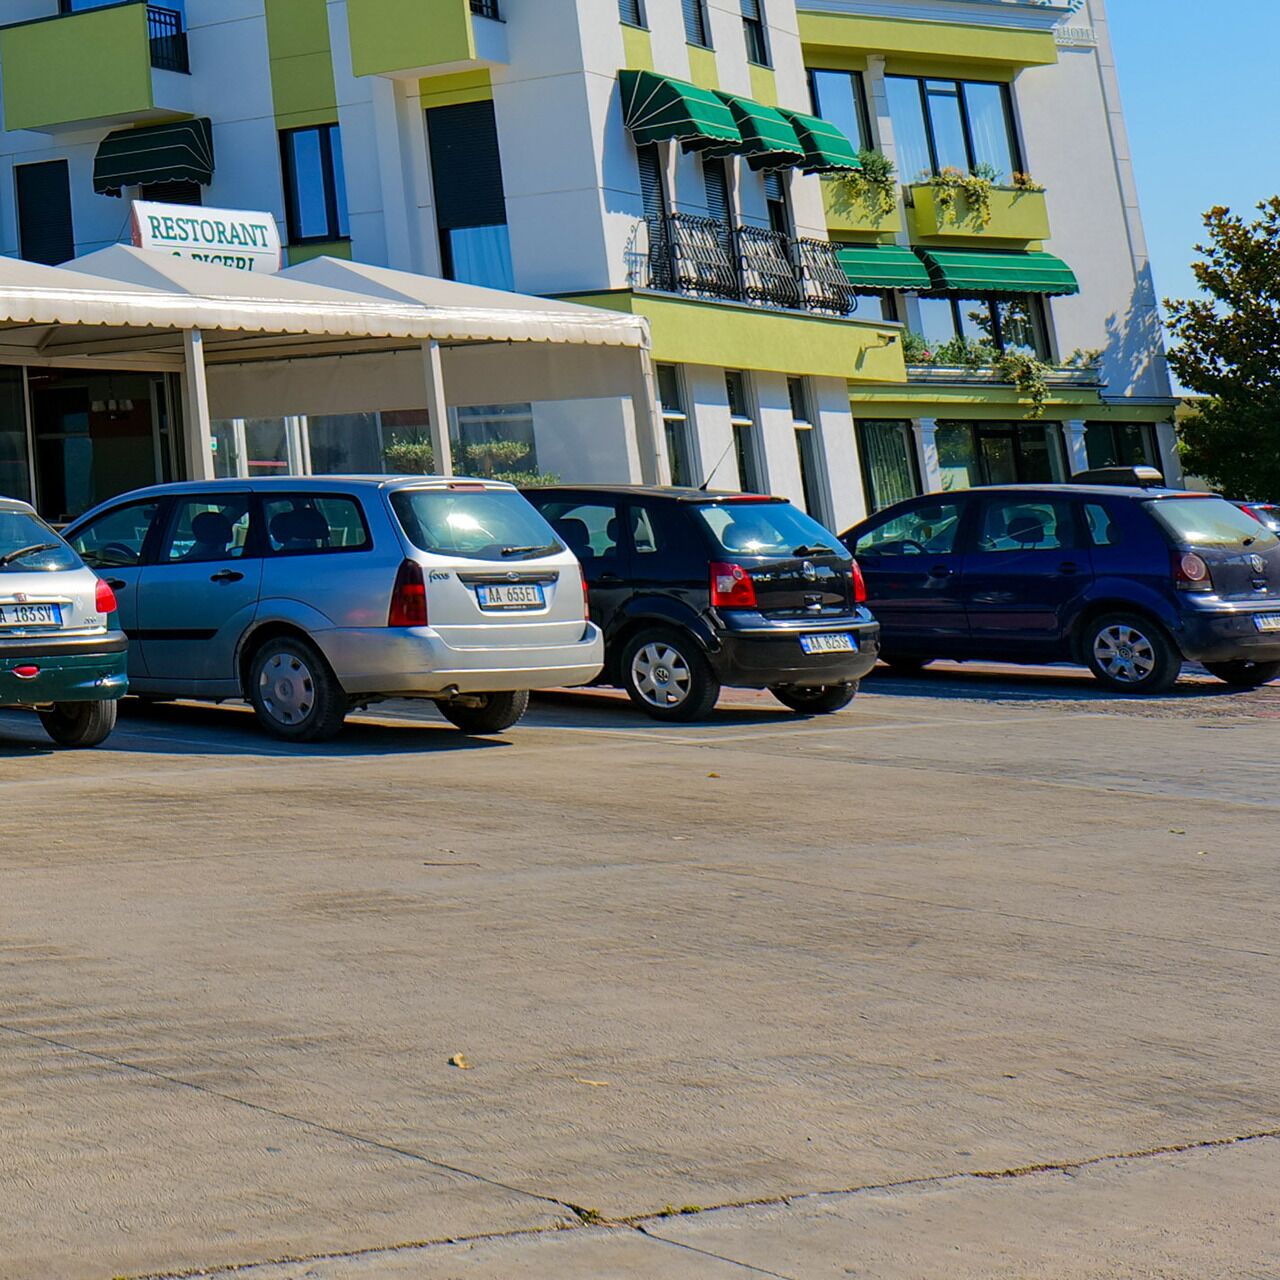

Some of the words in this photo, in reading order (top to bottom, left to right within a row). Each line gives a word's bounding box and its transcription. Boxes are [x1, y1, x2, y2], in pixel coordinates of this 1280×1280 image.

[147, 215, 268, 247] RESTORANT
[488, 587, 502, 602] AA
[507, 586, 538, 602] 653ET
[14, 606, 52, 623] 183SV
